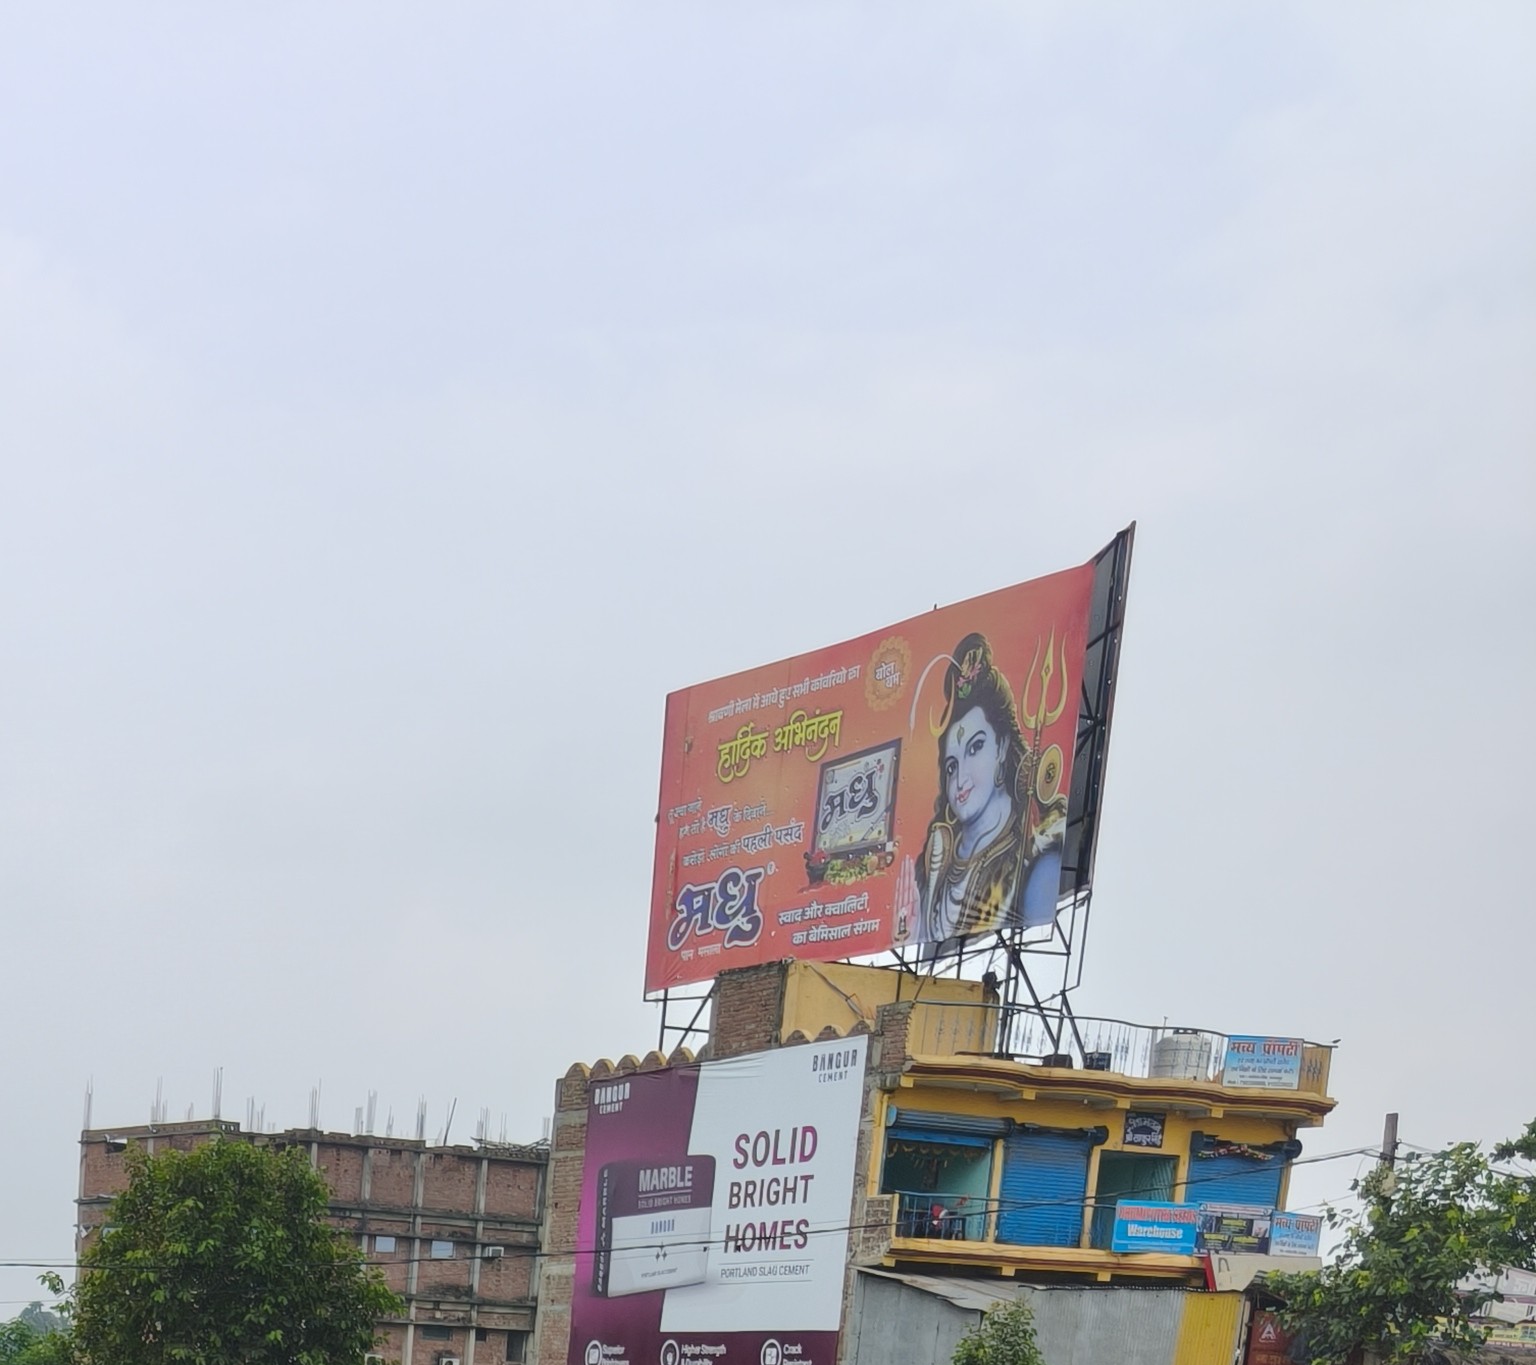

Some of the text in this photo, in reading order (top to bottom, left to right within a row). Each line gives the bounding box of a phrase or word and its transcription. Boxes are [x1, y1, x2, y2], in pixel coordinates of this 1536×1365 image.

[792, 677, 810, 698] सभी
[848, 664, 861, 680] का
[717, 708, 843, 783] हार्दिक अभिनंदन
[819, 767, 880, 834] मधु
[706, 804, 733, 838] मधु
[741, 822, 773, 855] पहली
[774, 816, 805, 844] पसंद
[667, 866, 765, 951] मधु
[778, 908, 803, 926] स्वाद
[803, 900, 824, 920] और
[792, 917, 881, 945] का बेमिसाल संगम
[812, 1049, 858, 1072] BANGUR
[818, 1070, 848, 1083] CEMENT
[594, 1082, 631, 1105] BANGUR
[599, 1101, 623, 1115] CEMENT
[732, 1125, 818, 1170] SOLID
[638, 1165, 693, 1192] MARBLE
[728, 1174, 814, 1210] BRIGHT
[723, 1218, 810, 1254] HOMES
[1127, 1223, 1184, 1239] Warehouse
[720, 1264, 810, 1279] PORTLAND SLAG CEMENT
